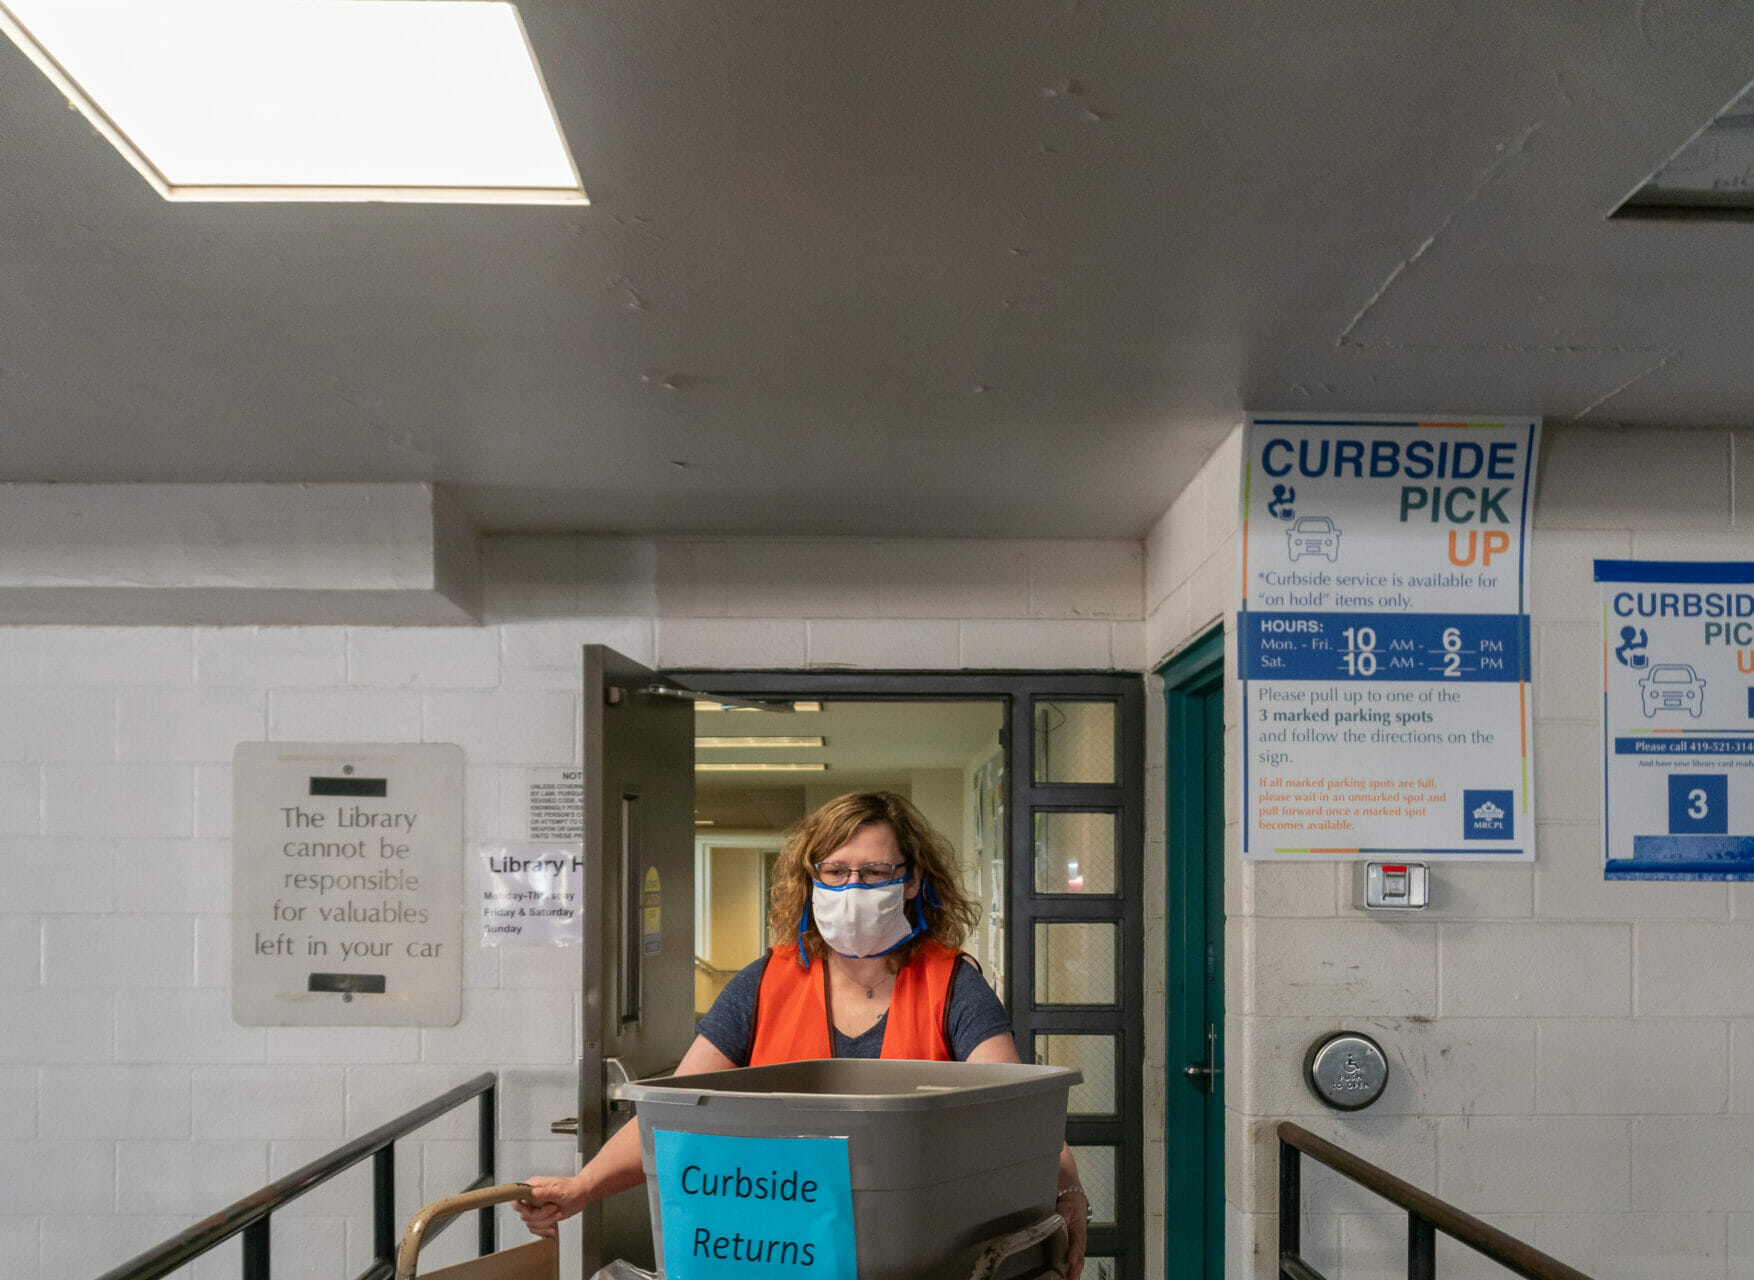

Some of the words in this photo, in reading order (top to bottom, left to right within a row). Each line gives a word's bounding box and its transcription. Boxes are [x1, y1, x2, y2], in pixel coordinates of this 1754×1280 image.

[1261, 438, 1518, 480] CURBSIDE
[1400, 486, 1511, 524] PICK
[1448, 530, 1510, 567] UP
[1336, 573, 1388, 587] service
[1392, 573, 1404, 587] is
[1407, 572, 1474, 588] available
[1477, 573, 1498, 588] for
[1335, 594, 1374, 608] items
[1378, 594, 1413, 611] only.
[1261, 619, 1324, 634] HOURS:
[1261, 637, 1297, 650] Mon.
[1312, 637, 1333, 650] Fri.
[1342, 627, 1376, 651] 10
[1389, 639, 1414, 651] AM
[1442, 627, 1462, 651] 6
[1480, 640, 1503, 652] PM
[1261, 655, 1286, 668] Sat.
[1343, 652, 1377, 676] 10
[1389, 656, 1414, 669] AM
[1443, 653, 1462, 677] 2
[1480, 657, 1503, 670] PM
[1259, 687, 1306, 702] Please
[1310, 688, 1338, 706] pull
[1343, 691, 1363, 706] up
[1367, 690, 1382, 702] to
[1386, 691, 1415, 703] one
[1418, 688, 1434, 703] of
[1437, 688, 1461, 703] the
[1259, 708, 1268, 722] 3
[1273, 707, 1330, 722] marked
[1334, 708, 1391, 726] parking
[1394, 709, 1434, 726] spots
[1258, 728, 1287, 743] and
[1291, 728, 1338, 743] follow
[1343, 729, 1367, 744] the
[1371, 729, 1443, 744] directions
[1447, 733, 1467, 744] on
[1471, 730, 1495, 745] the
[1635, 741, 1666, 752] Please
[1669, 741, 1687, 752] call
[1690, 741, 1754, 753] 419-521-314
[1258, 750, 1293, 766] sign.
[1259, 778, 1266, 788] If
[1269, 777, 1282, 788] all
[1285, 777, 1324, 789] marked
[1327, 778, 1366, 791] parking
[1369, 779, 1395, 791] spots
[1398, 781, 1414, 789] are
[1417, 778, 1437, 791] full,
[1259, 791, 1297, 804] please
[1300, 792, 1317, 803] wait
[1320, 792, 1329, 803] in
[1332, 794, 1346, 803] an
[1348, 791, 1400, 803] unmarked
[1403, 793, 1424, 805] spot
[1427, 792, 1447, 803] and
[1687, 788, 1708, 819] 3
[280, 806, 326, 829] The
[338, 806, 418, 834] Library
[1259, 805, 1278, 818] pull
[1281, 805, 1323, 817] forward
[1325, 808, 1351, 817] once
[1362, 806, 1402, 817] marked
[1404, 807, 1426, 819] spot
[1259, 819, 1304, 831] becomes
[1307, 819, 1355, 832] available.
[283, 839, 367, 860] cannot
[380, 836, 410, 860] be
[490, 856, 564, 877] Library
[284, 868, 420, 896] responsible
[273, 900, 307, 923] for
[318, 901, 429, 925] valuables
[529, 908, 575, 918] Saturday
[255, 932, 295, 956] left
[307, 935, 328, 956] in
[340, 940, 393, 962] your
[406, 942, 443, 959] car
[681, 1165, 818, 1203] Curbside
[693, 1228, 816, 1266] Returns
